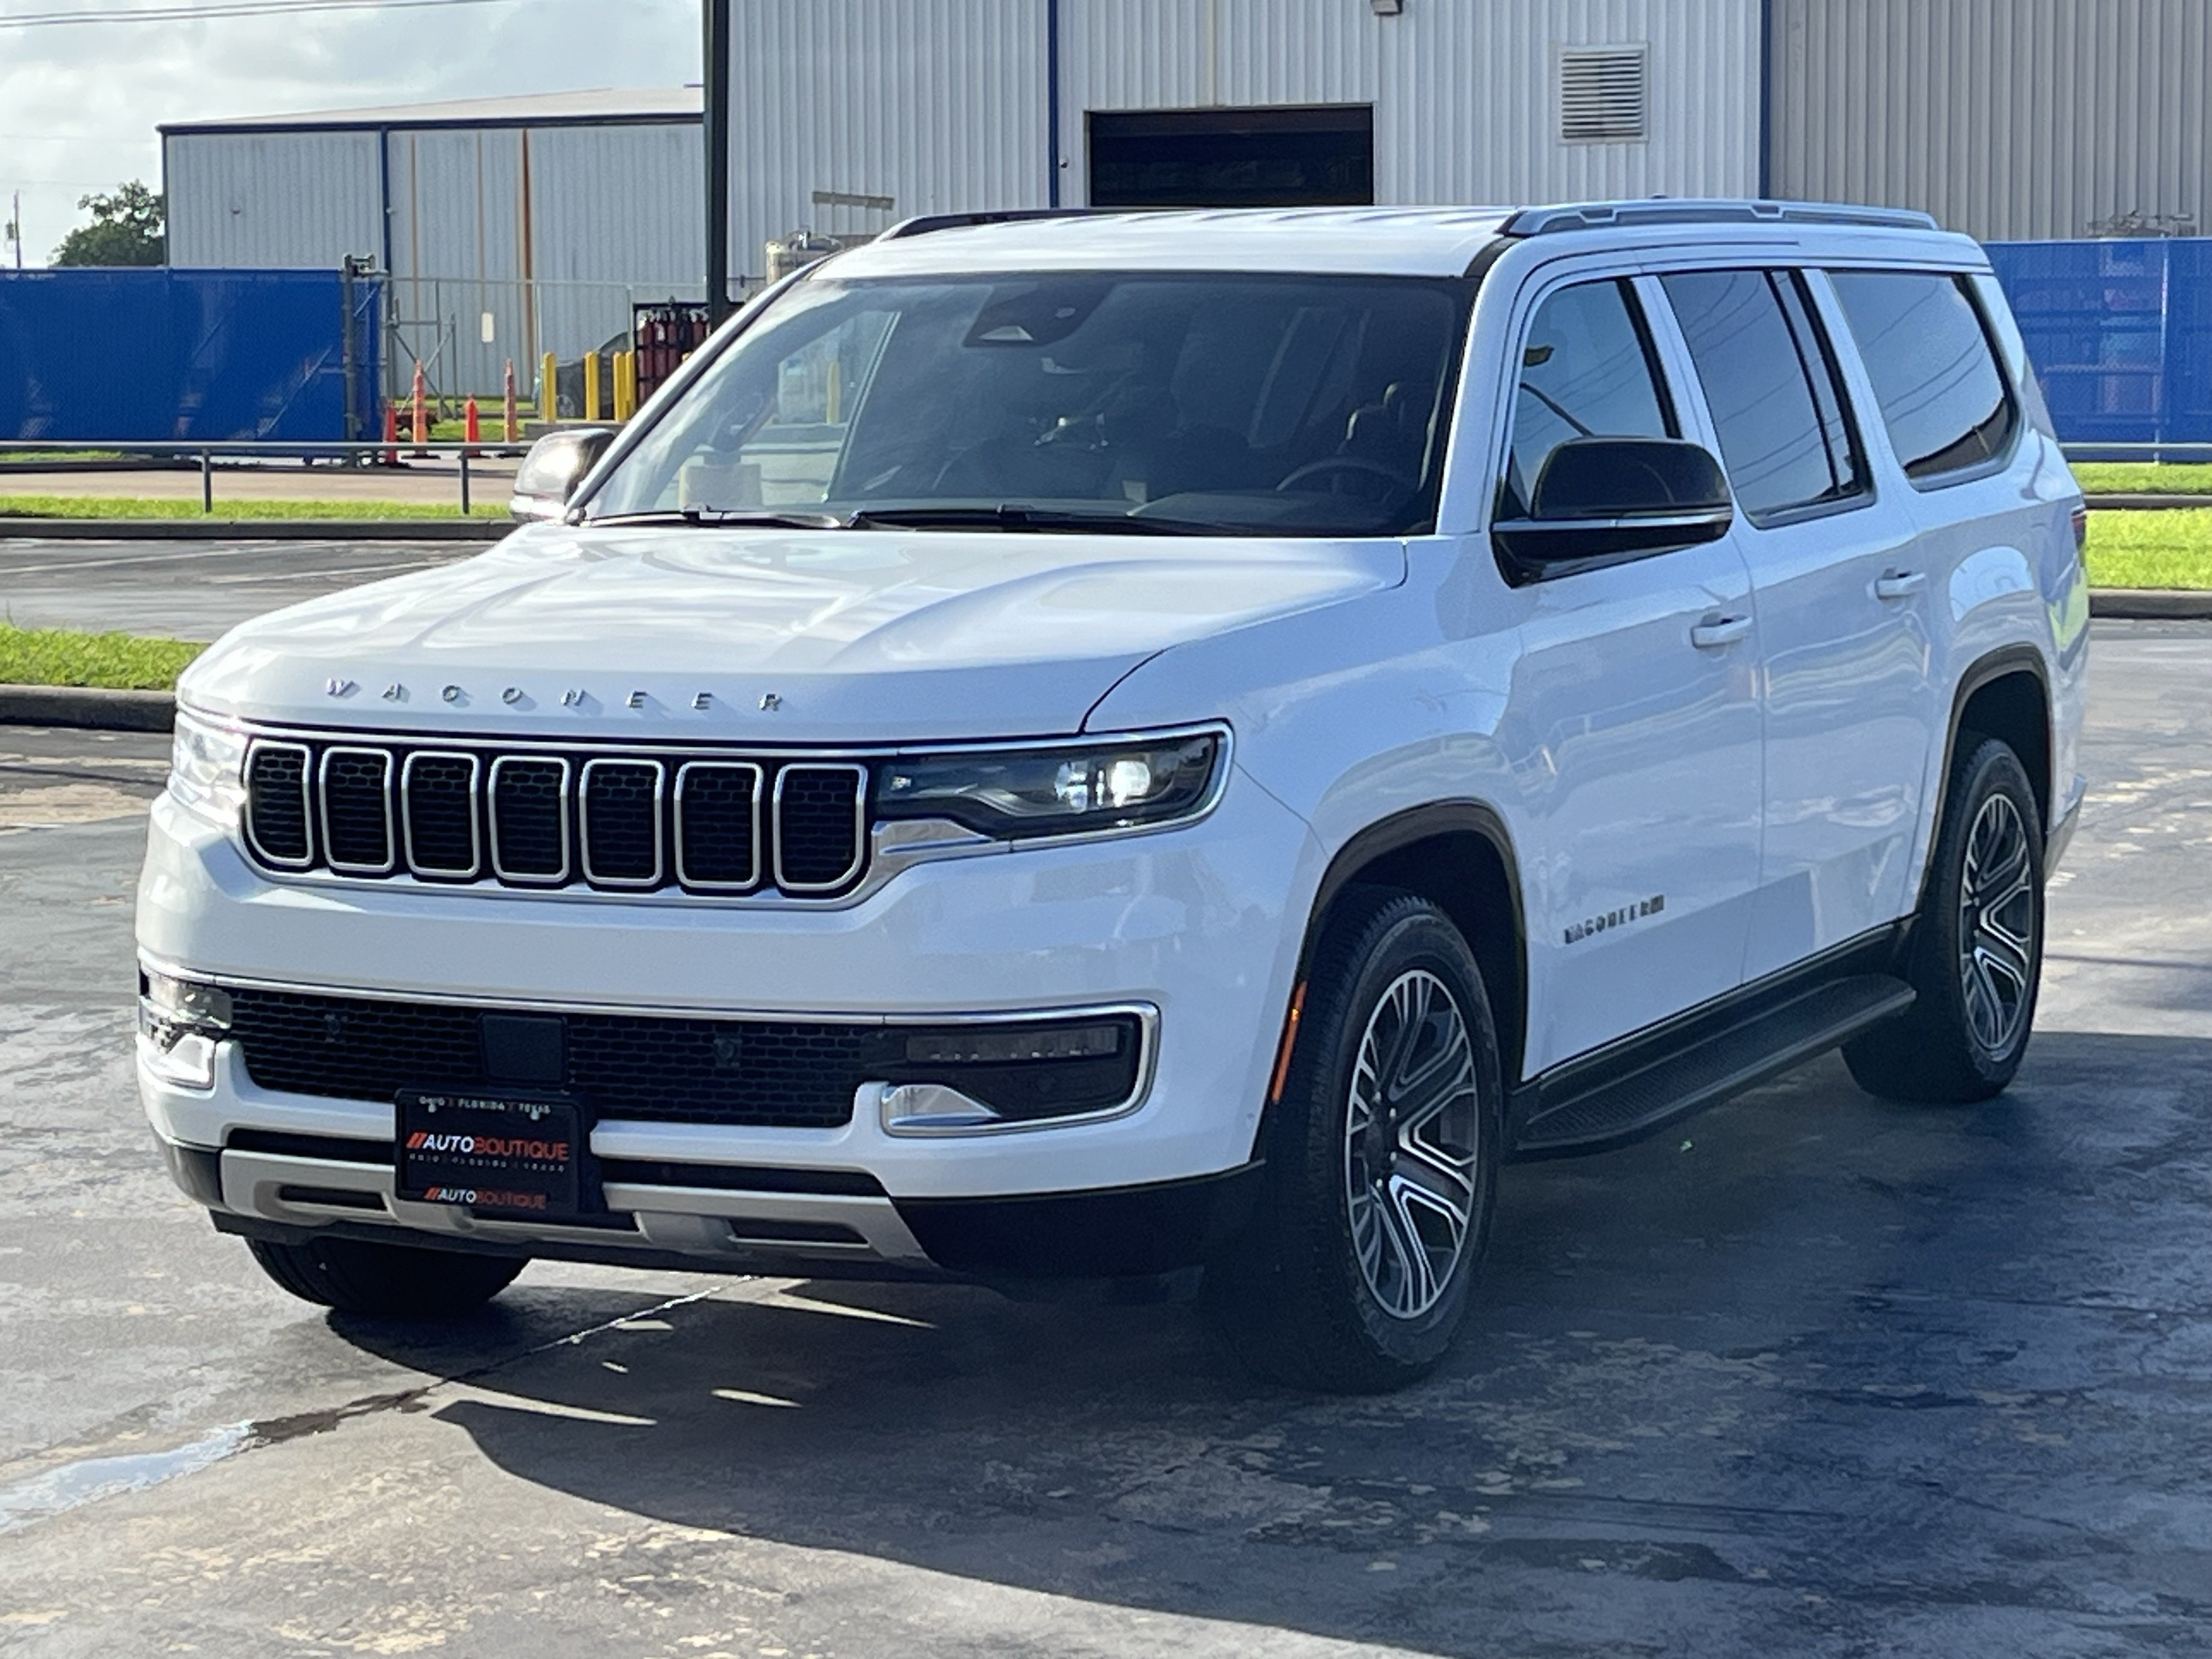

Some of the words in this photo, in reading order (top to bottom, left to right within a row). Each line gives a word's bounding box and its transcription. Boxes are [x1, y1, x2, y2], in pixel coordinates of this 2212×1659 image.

[328, 678, 782, 712] WAGONEER
[458, 1098, 505, 1111] FLORIDA
[422, 1134, 569, 1161] AUTOBOUTIQUE
[437, 1188, 546, 1209] AUTOBOUTIQUE
